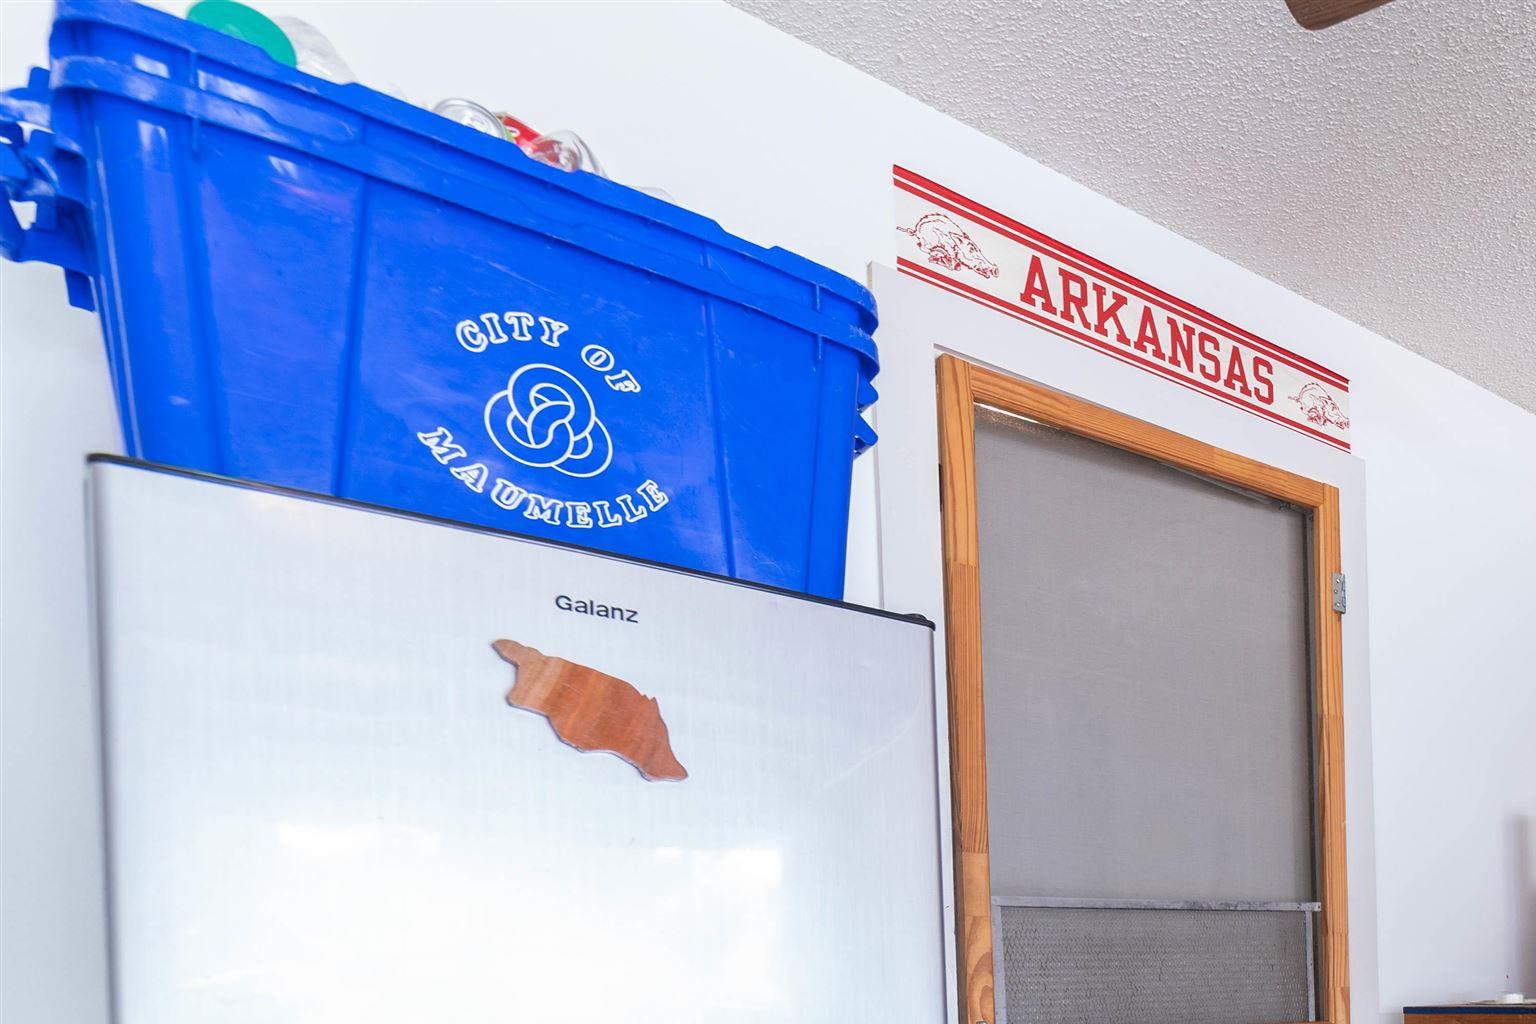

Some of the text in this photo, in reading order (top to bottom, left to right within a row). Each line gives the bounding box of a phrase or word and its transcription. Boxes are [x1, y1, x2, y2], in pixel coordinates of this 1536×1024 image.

[455, 311, 641, 393] CITY OF
[1019, 254, 1274, 406] ARKANSAS
[417, 426, 669, 529] MAUMELLE
[555, 594, 639, 623] Galanz
